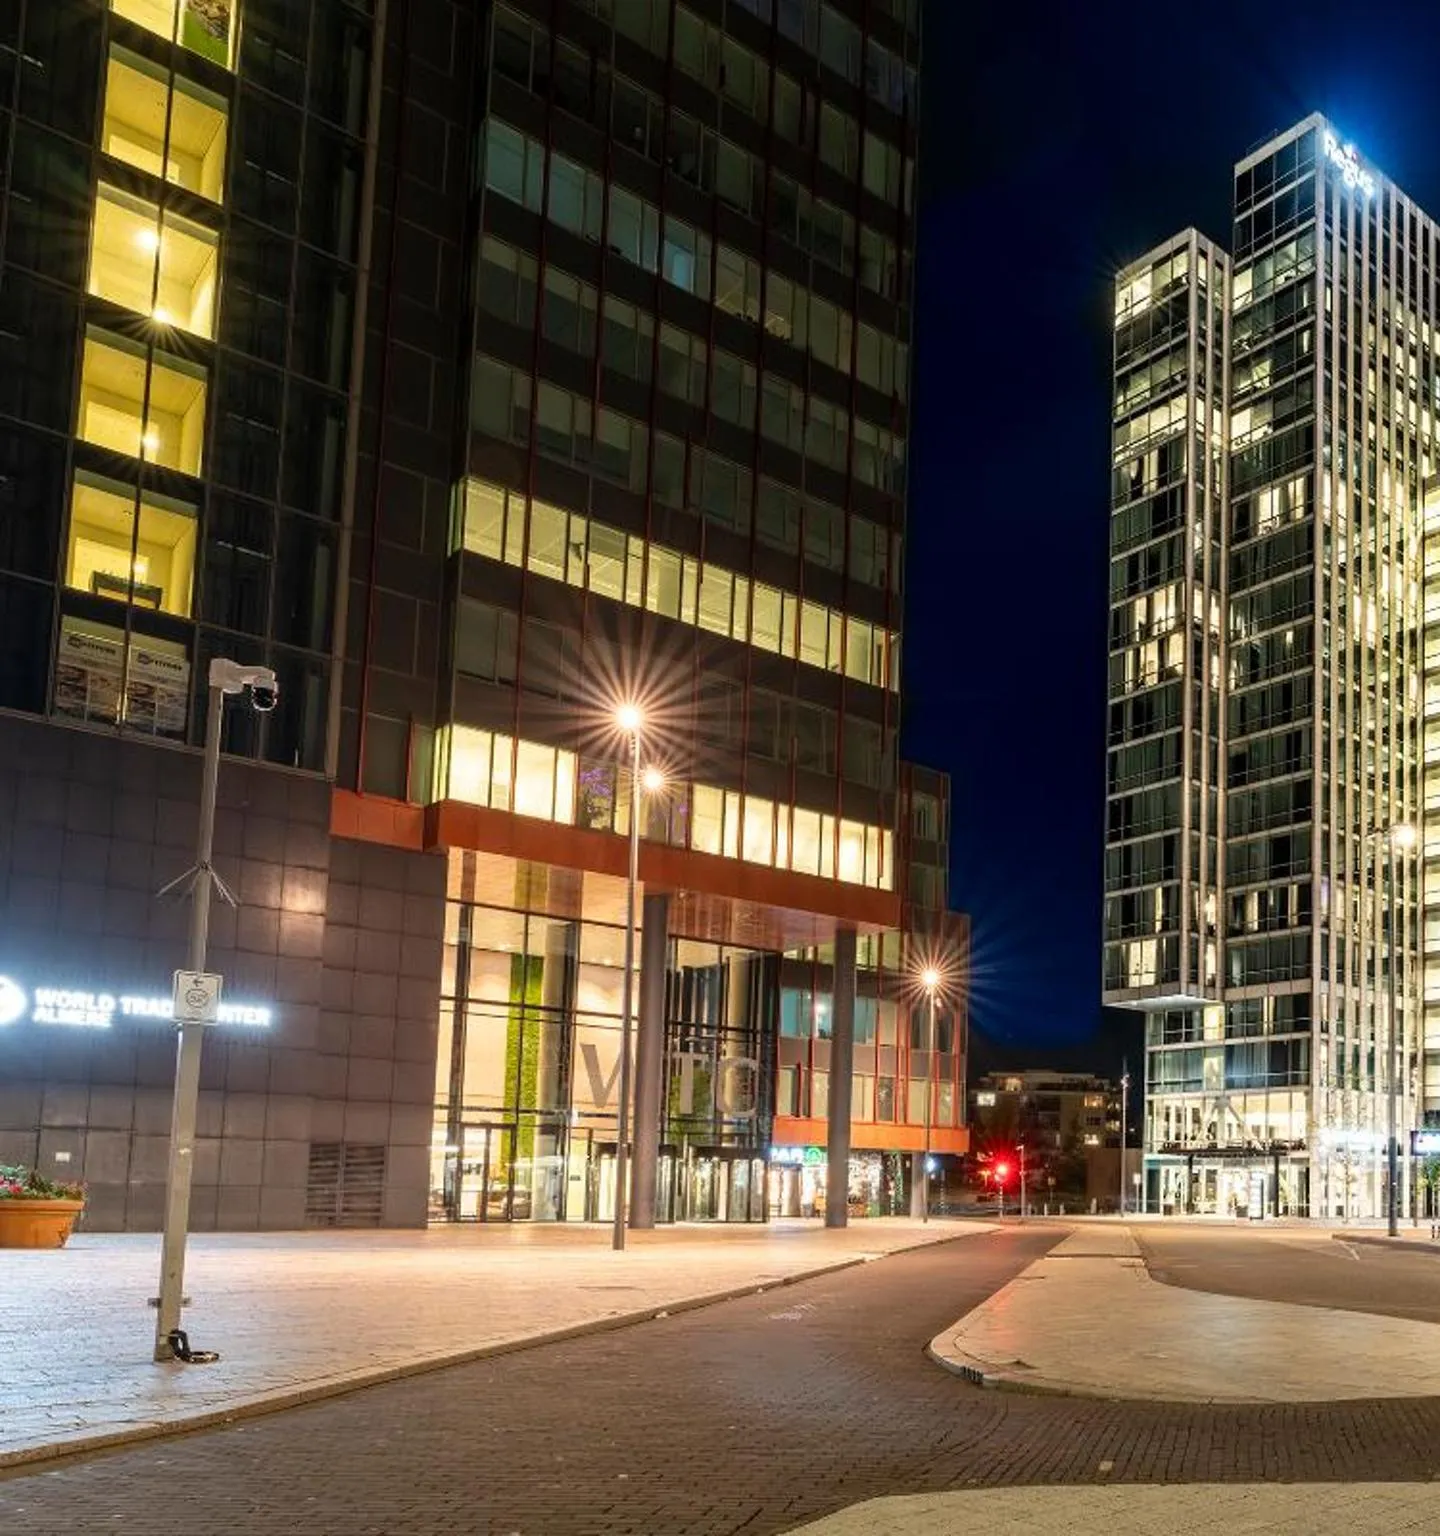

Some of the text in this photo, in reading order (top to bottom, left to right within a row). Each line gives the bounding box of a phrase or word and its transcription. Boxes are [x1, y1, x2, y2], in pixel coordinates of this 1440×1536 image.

[33, 1007, 112, 1027] ALMERE
[35, 988, 116, 1012] WORLD
[120, 995, 174, 1018] TRAD
[218, 1004, 270, 1026] NTER
